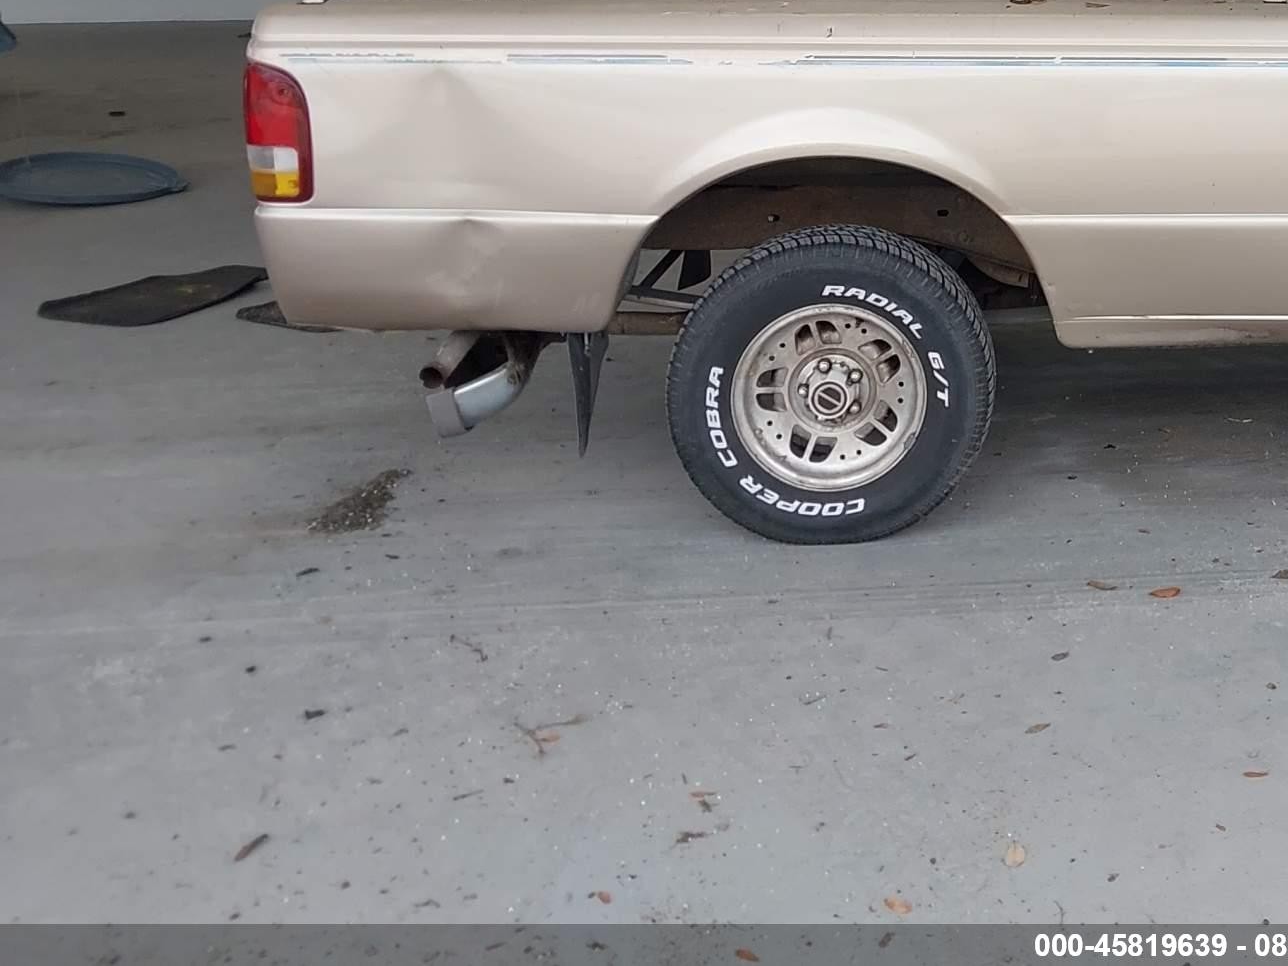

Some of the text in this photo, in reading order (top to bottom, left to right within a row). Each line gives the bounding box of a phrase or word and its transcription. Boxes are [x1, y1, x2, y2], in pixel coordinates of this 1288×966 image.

[821, 284, 951, 408] RADIAL G/T
[703, 365, 867, 518] COOPER COBRA
